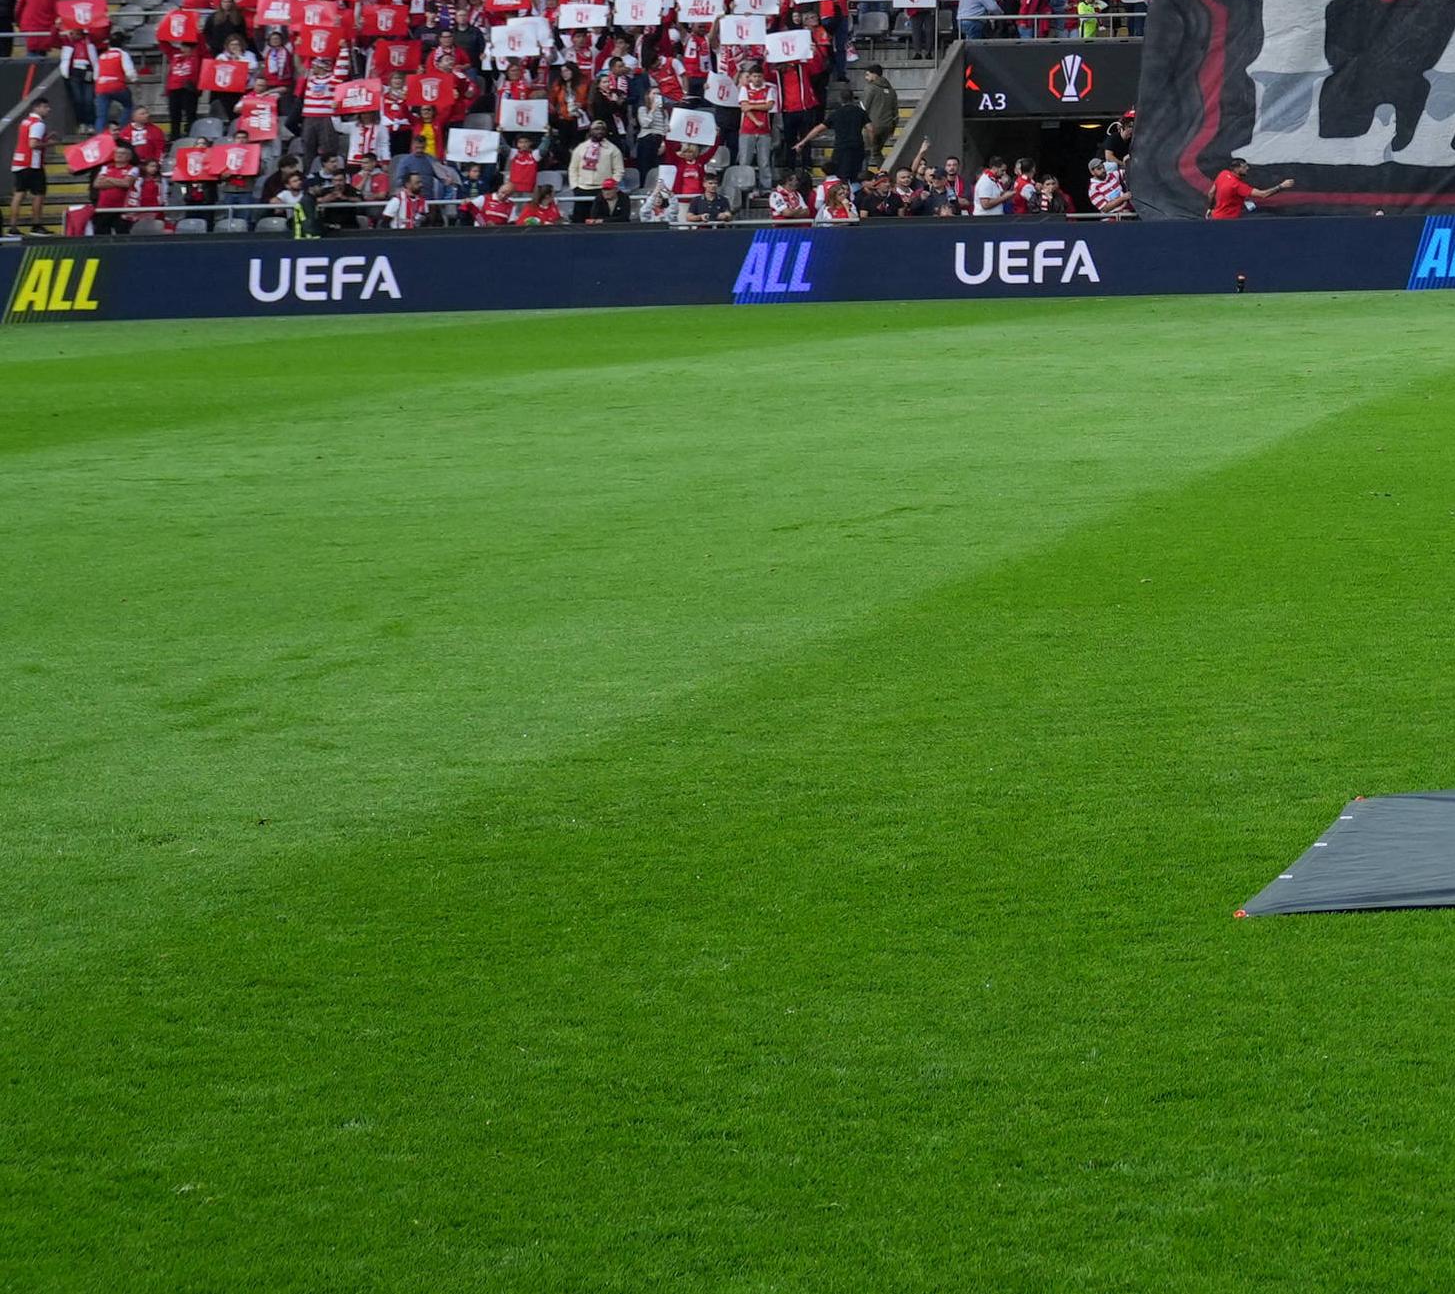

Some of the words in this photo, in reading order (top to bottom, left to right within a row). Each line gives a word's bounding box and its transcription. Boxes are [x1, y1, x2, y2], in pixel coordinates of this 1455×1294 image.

[979, 93, 1007, 112] A3
[11, 258, 100, 313] ALL
[248, 255, 402, 304] UEFA
[733, 240, 813, 294] ALL
[954, 238, 1101, 286] UEFA
